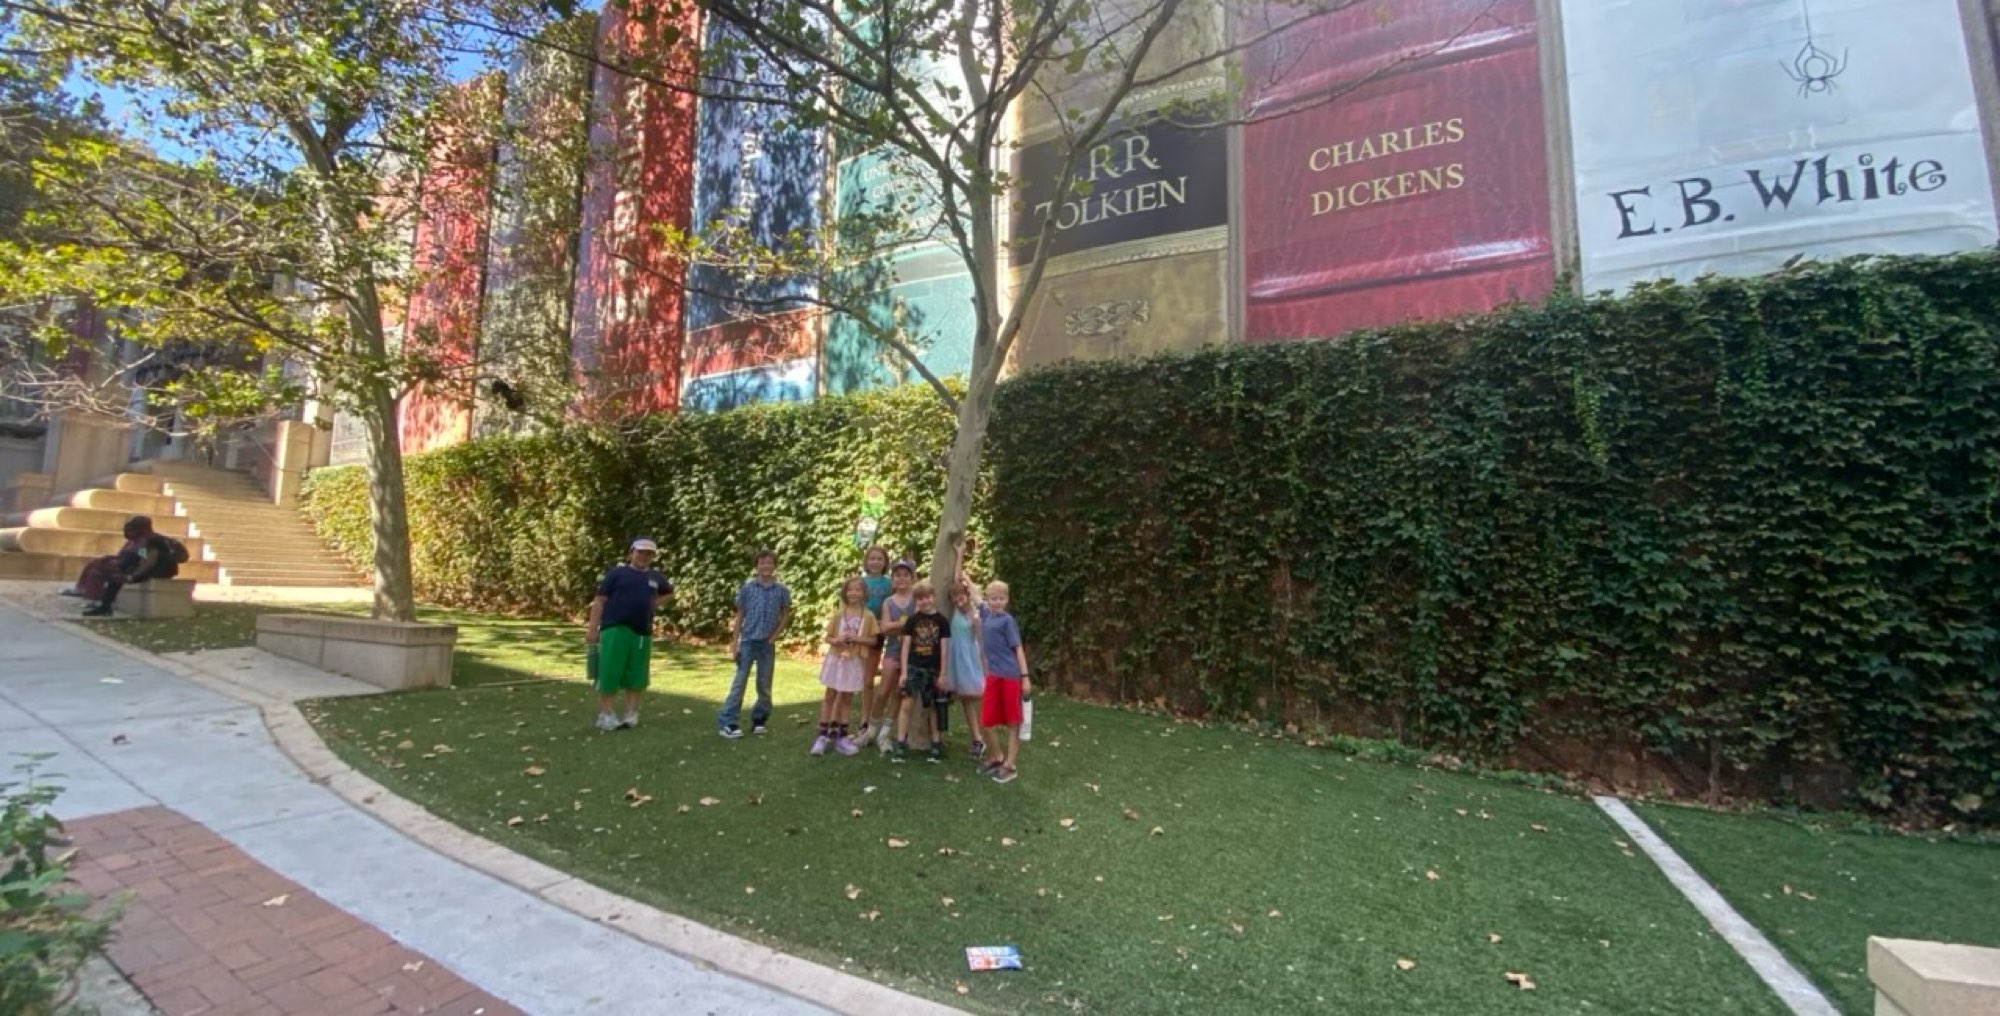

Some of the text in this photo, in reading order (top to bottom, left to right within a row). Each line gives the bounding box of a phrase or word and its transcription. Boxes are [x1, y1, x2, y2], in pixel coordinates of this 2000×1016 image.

[1069, 135, 1162, 193] .R.R.
[1308, 118, 1465, 172] CHARLES
[1310, 163, 1465, 217] DICKENS
[1745, 152, 1948, 211] White
